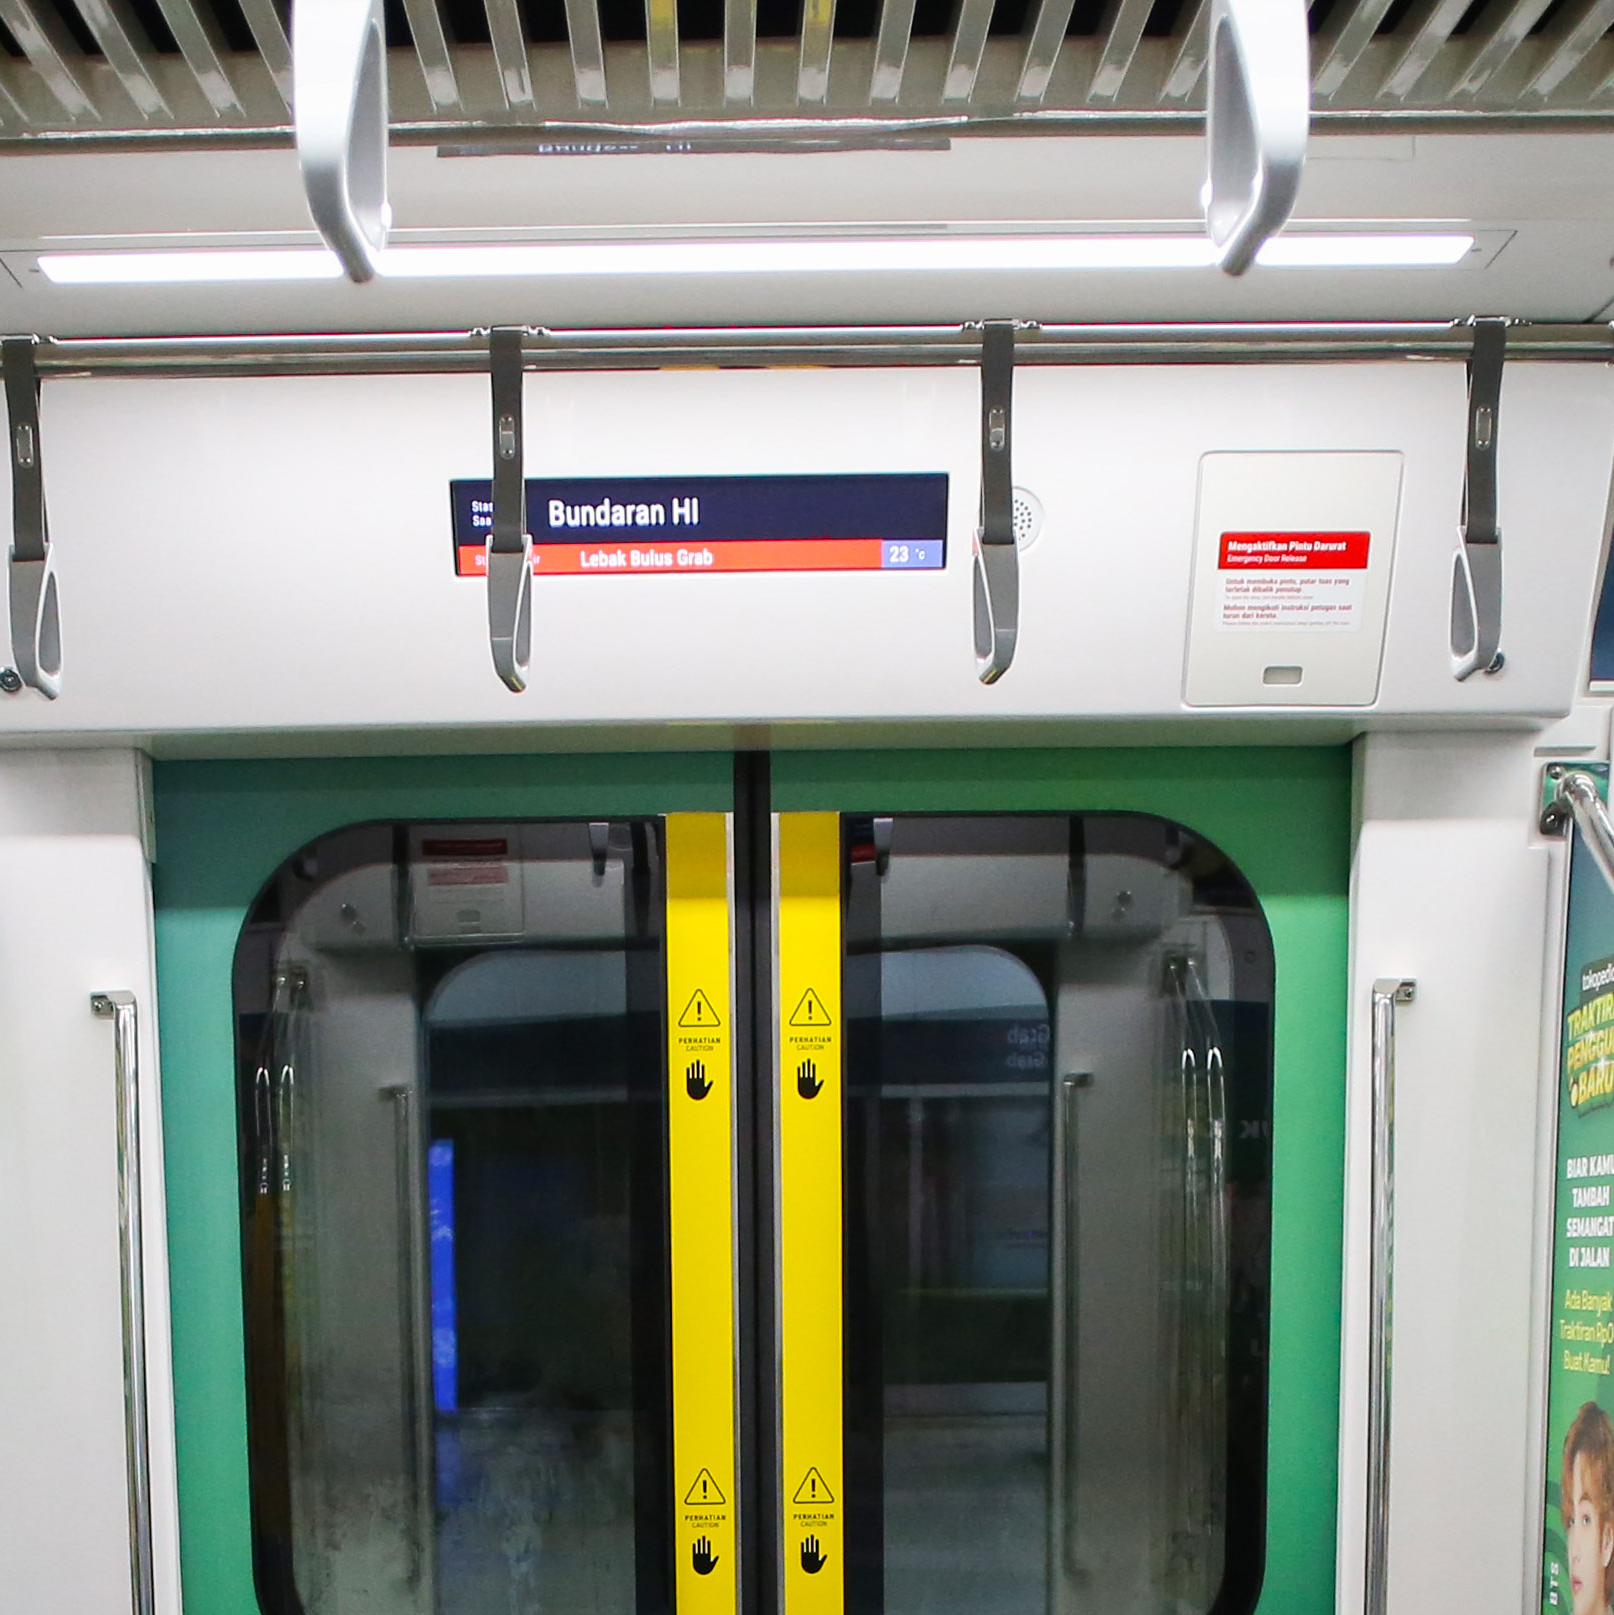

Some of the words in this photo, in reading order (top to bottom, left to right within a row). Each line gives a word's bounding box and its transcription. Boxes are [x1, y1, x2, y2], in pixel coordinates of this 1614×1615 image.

[548, 498, 665, 528] Bundaran
[672, 497, 699, 526] HI
[580, 550, 627, 567] Lebak
[630, 548, 673, 566] Bulus
[676, 548, 713, 566] Grab
[889, 545, 909, 563] 23
[1227, 540, 1288, 553] Mengaktifkan
[1289, 541, 1313, 551] Pintu
[1313, 541, 1347, 551] Darurat
[1227, 554, 1263, 564] Emergency
[1264, 554, 1280, 562] Door
[1281, 554, 1307, 562] Release
[1566, 1156, 1588, 1179] BIAR
[1572, 1185, 1611, 1209] TAMBAH
[1565, 1215, 1614, 1239] SEMANGAT
[1569, 1247, 1579, 1268] DI
[1580, 1246, 1611, 1268] JALAN
[1564, 1289, 1582, 1310] Ada
[1582, 1289, 1613, 1317] Banyak
[1559, 1319, 1596, 1341] Traktiran
[1563, 1349, 1584, 1371] Buat
[1583, 1351, 1611, 1375] Kamu!
[684, 1514, 726, 1522] PERHATIAN
[793, 1513, 835, 1521] PERHATIAN
[1549, 1561, 1559, 1606] BTS
